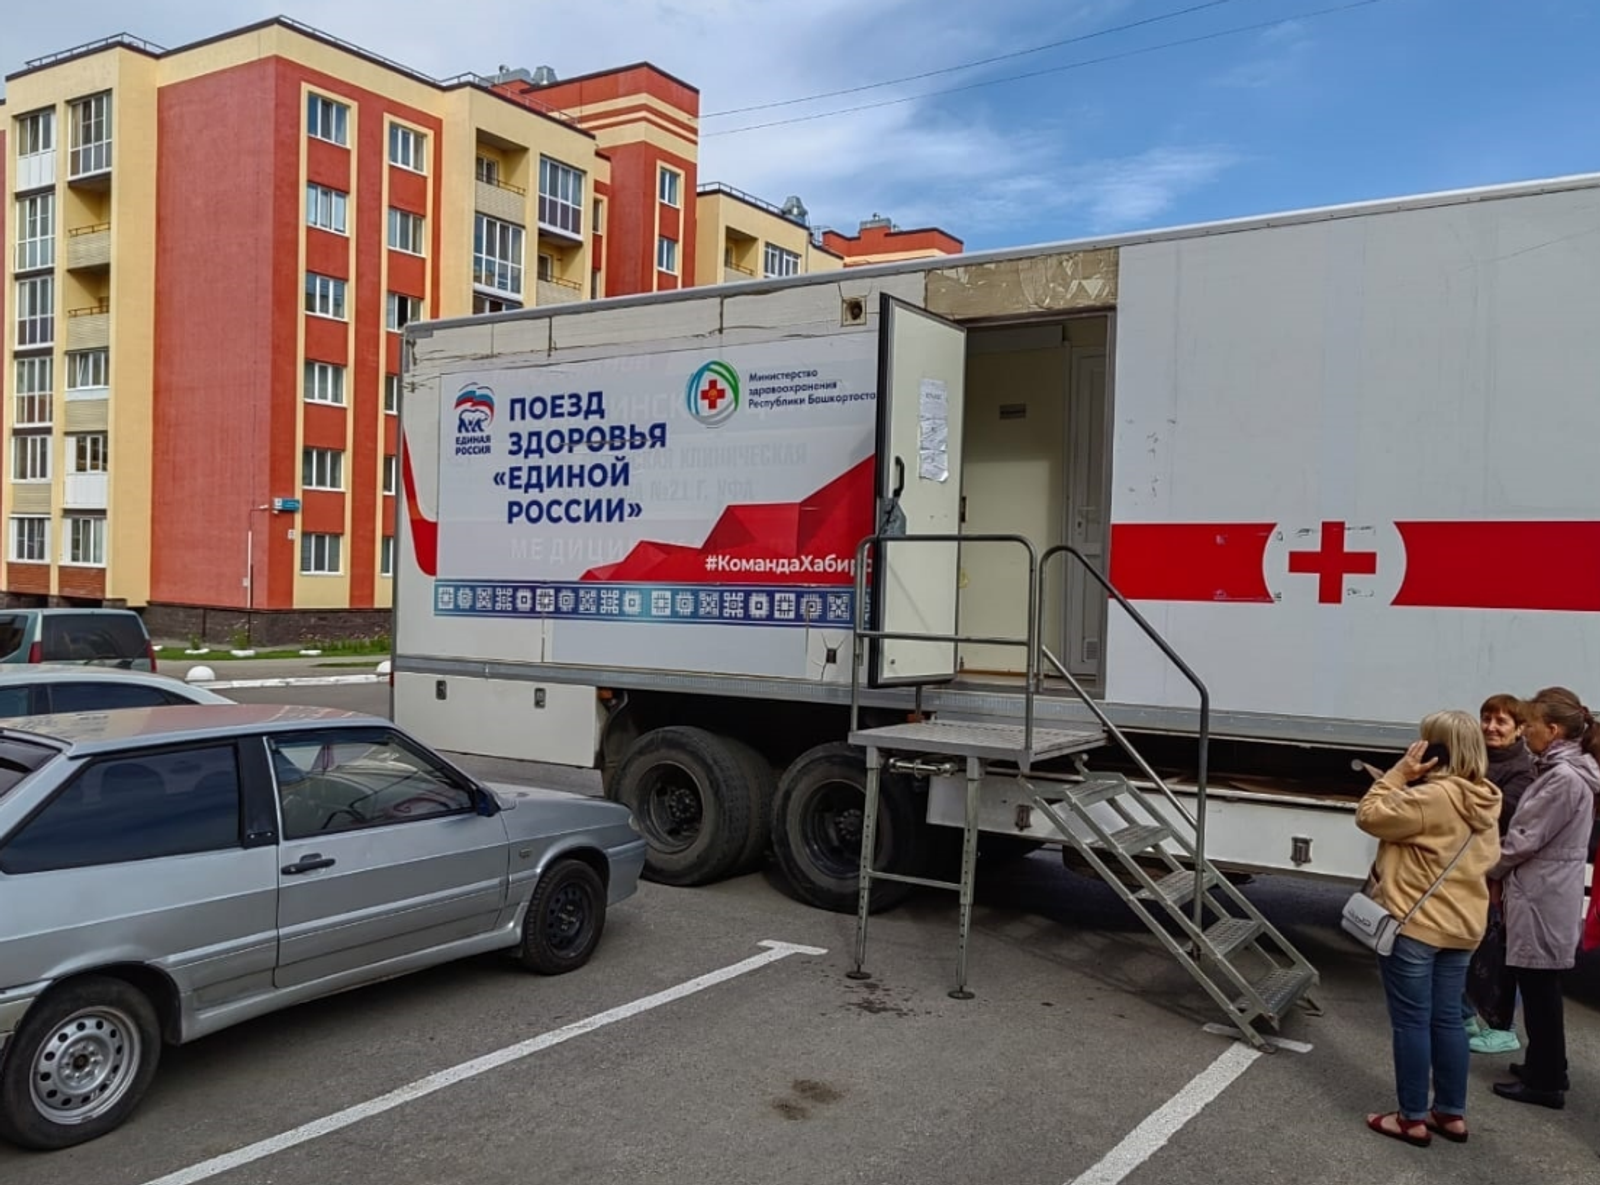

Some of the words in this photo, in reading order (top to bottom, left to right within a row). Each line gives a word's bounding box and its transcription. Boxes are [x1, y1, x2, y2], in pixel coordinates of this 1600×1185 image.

[749, 370, 818, 382] Министерство
[749, 381, 837, 397] здравоохранения
[509, 391, 605, 421] ПОЕЗД
[749, 395, 805, 410] Республики
[808, 391, 877, 405] Башкортоста
[455, 434, 491, 446] ЕДИНАЯ
[508, 422, 667, 459] ЗДОРОВЬЯ
[455, 445, 491, 456] РОССИЯ
[493, 456, 630, 493] «ЕДИНОЙ
[507, 498, 642, 524] РОССИИ»
[705, 554, 873, 576] #КомандаХабир
